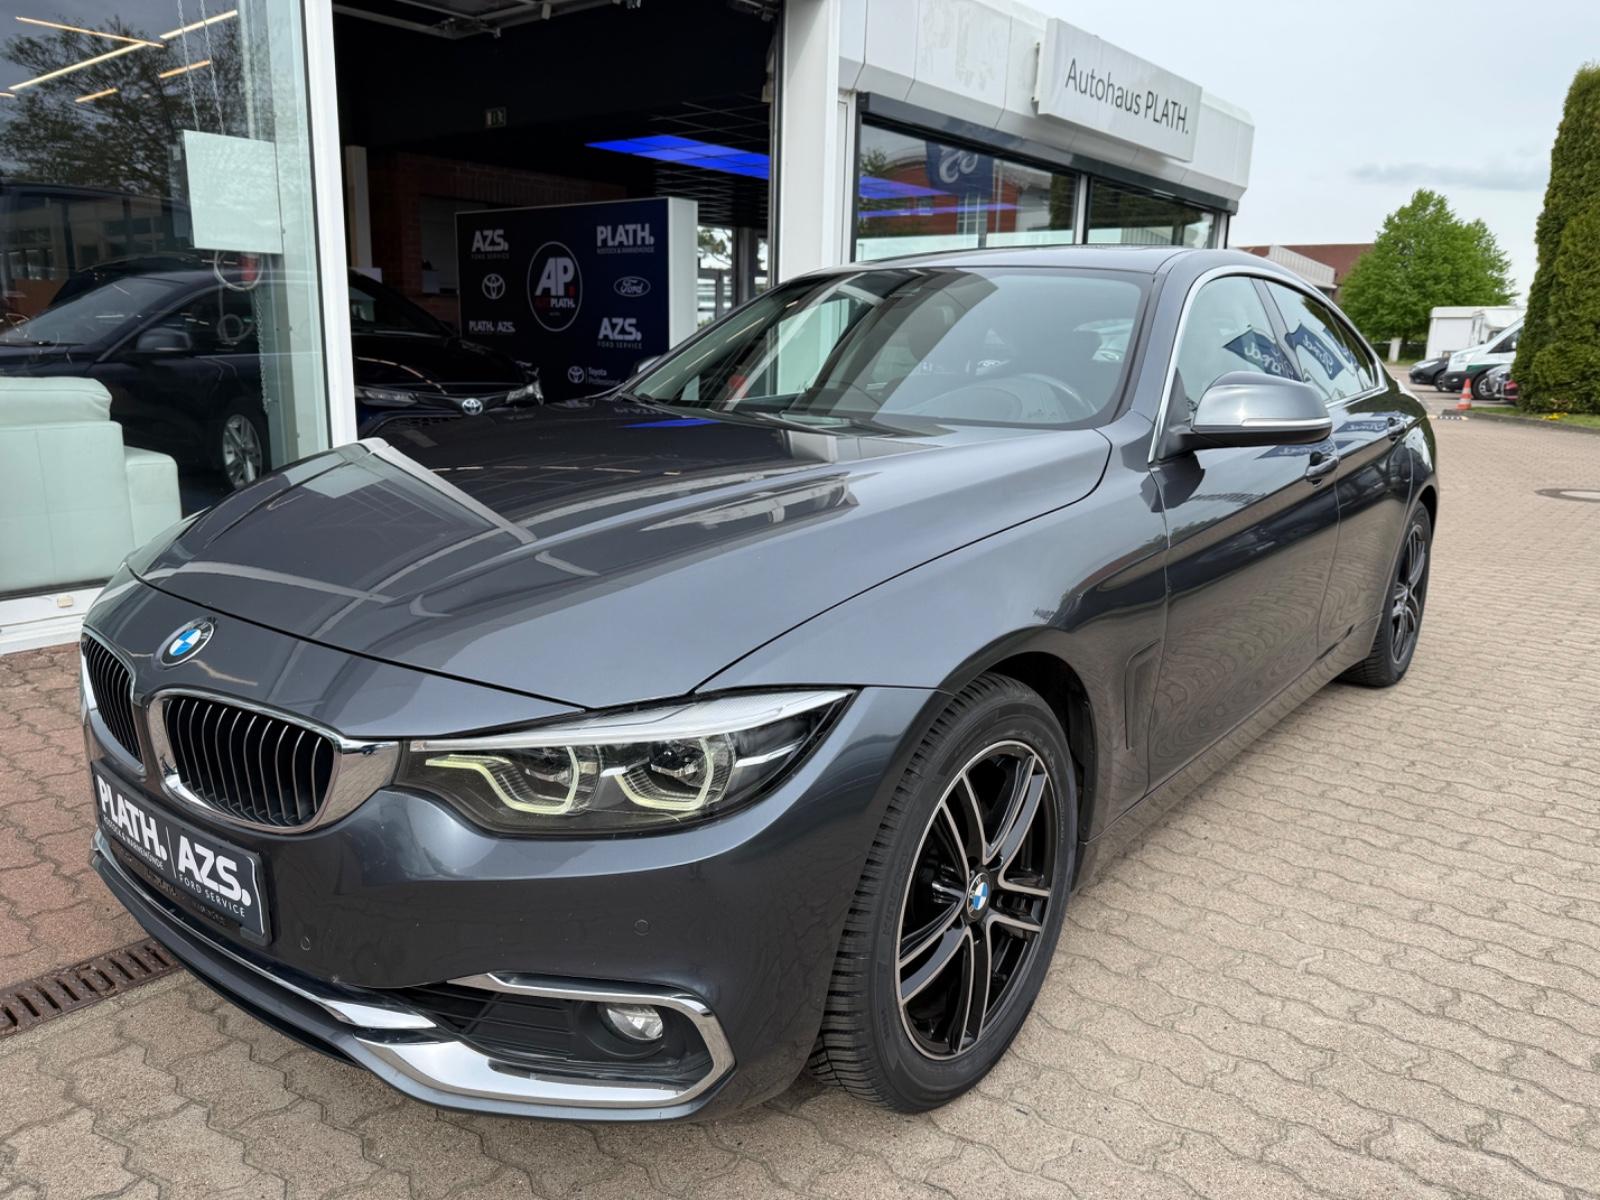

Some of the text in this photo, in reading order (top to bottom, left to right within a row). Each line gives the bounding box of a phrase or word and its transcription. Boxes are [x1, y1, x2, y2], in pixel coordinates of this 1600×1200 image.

[1065, 57, 1190, 135] Autohaus PLATH.
[471, 228, 510, 252] AZS.
[596, 223, 655, 247] PLATH.
[620, 279, 645, 295] Ford
[550, 297, 576, 308] PLATH.
[597, 318, 643, 341] AZS.
[97, 774, 252, 907] PLATH. AZS.
[179, 873, 202, 895] FORD
[204, 888, 246, 919] SERVICE
